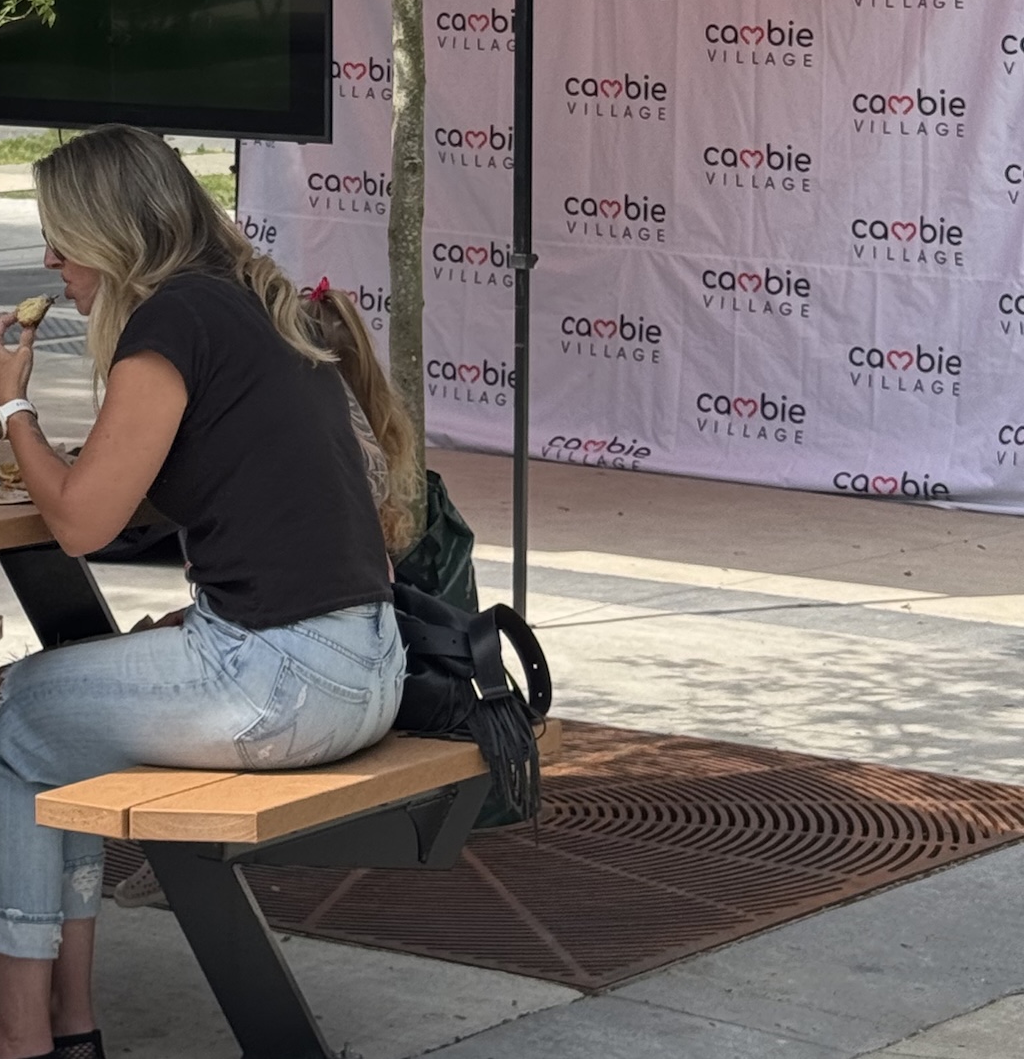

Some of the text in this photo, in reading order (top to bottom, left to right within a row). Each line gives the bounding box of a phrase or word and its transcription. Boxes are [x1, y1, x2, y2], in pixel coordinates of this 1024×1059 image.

[436, 7, 515, 33] cambi
[705, 19, 814, 47] cambie
[437, 36, 515, 52] VILLAG
[331, 56, 391, 82] ambi
[707, 49, 813, 68] VILLAGE
[565, 73, 667, 101] cambie
[567, 102, 666, 121] VILLAGE
[853, 88, 965, 117] cambie
[435, 124, 513, 151] cambi
[854, 119, 964, 138] VILLAGE
[438, 151, 514, 169] VILLAG
[703, 143, 811, 172] cambie
[705, 172, 811, 192] VILLAGE
[309, 196, 386, 215] VILLAG
[564, 194, 666, 222] cambie
[566, 221, 665, 242] VILLAGE
[851, 216, 963, 246] cambie
[433, 241, 511, 269] cambi
[853, 244, 964, 267] VILLAGE
[434, 266, 513, 288] VILLAG
[702, 268, 810, 298] cambie
[703, 294, 809, 318] VILLAGE
[561, 314, 662, 343] cambie
[561, 341, 660, 364] VILLAGE
[848, 344, 962, 375] cambie
[428, 384, 507, 406] VILLAG
[850, 372, 960, 397] VILLAGE
[696, 393, 806, 423] cambie
[697, 417, 803, 444] VILLAGE
